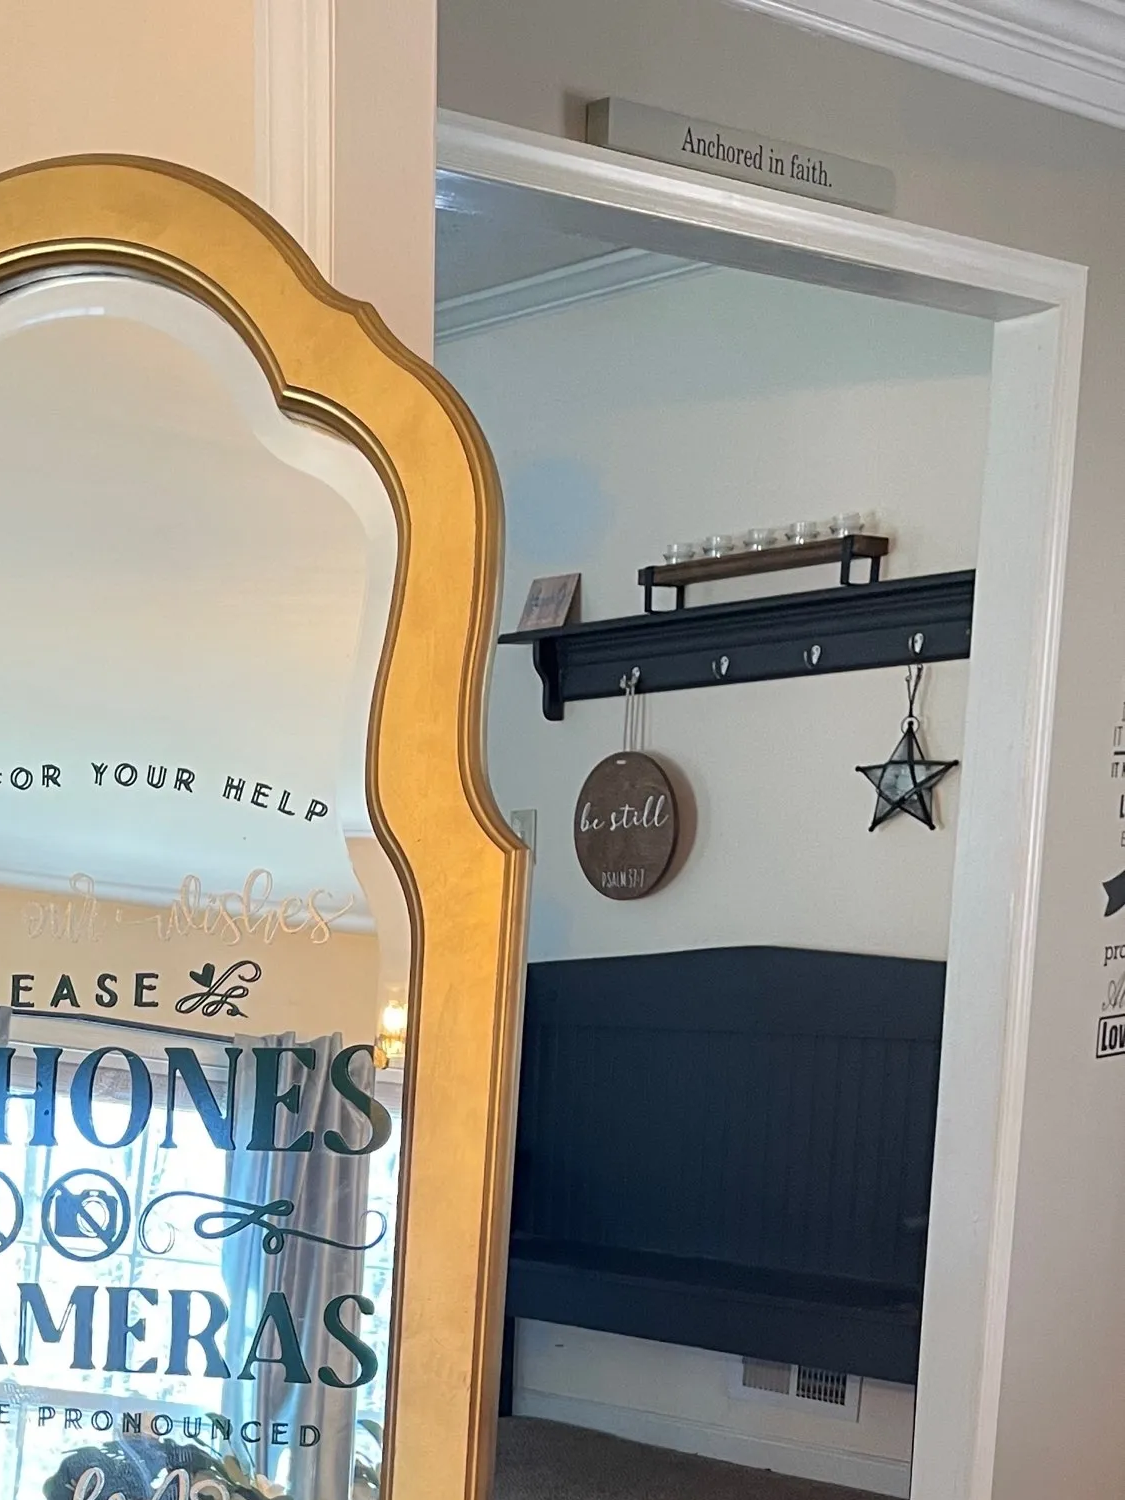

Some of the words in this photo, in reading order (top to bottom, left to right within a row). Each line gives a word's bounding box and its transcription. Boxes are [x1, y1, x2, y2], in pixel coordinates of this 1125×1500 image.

[681, 126, 763, 171] Anchored
[769, 149, 785, 176] in
[790, 155, 833, 188] faith.
[91, 761, 196, 794] YOUR
[222, 775, 329, 823] HELP
[580, 802, 605, 832] be
[610, 795, 669, 831] still
[38, 1404, 323, 1448] PRONOUNCED
